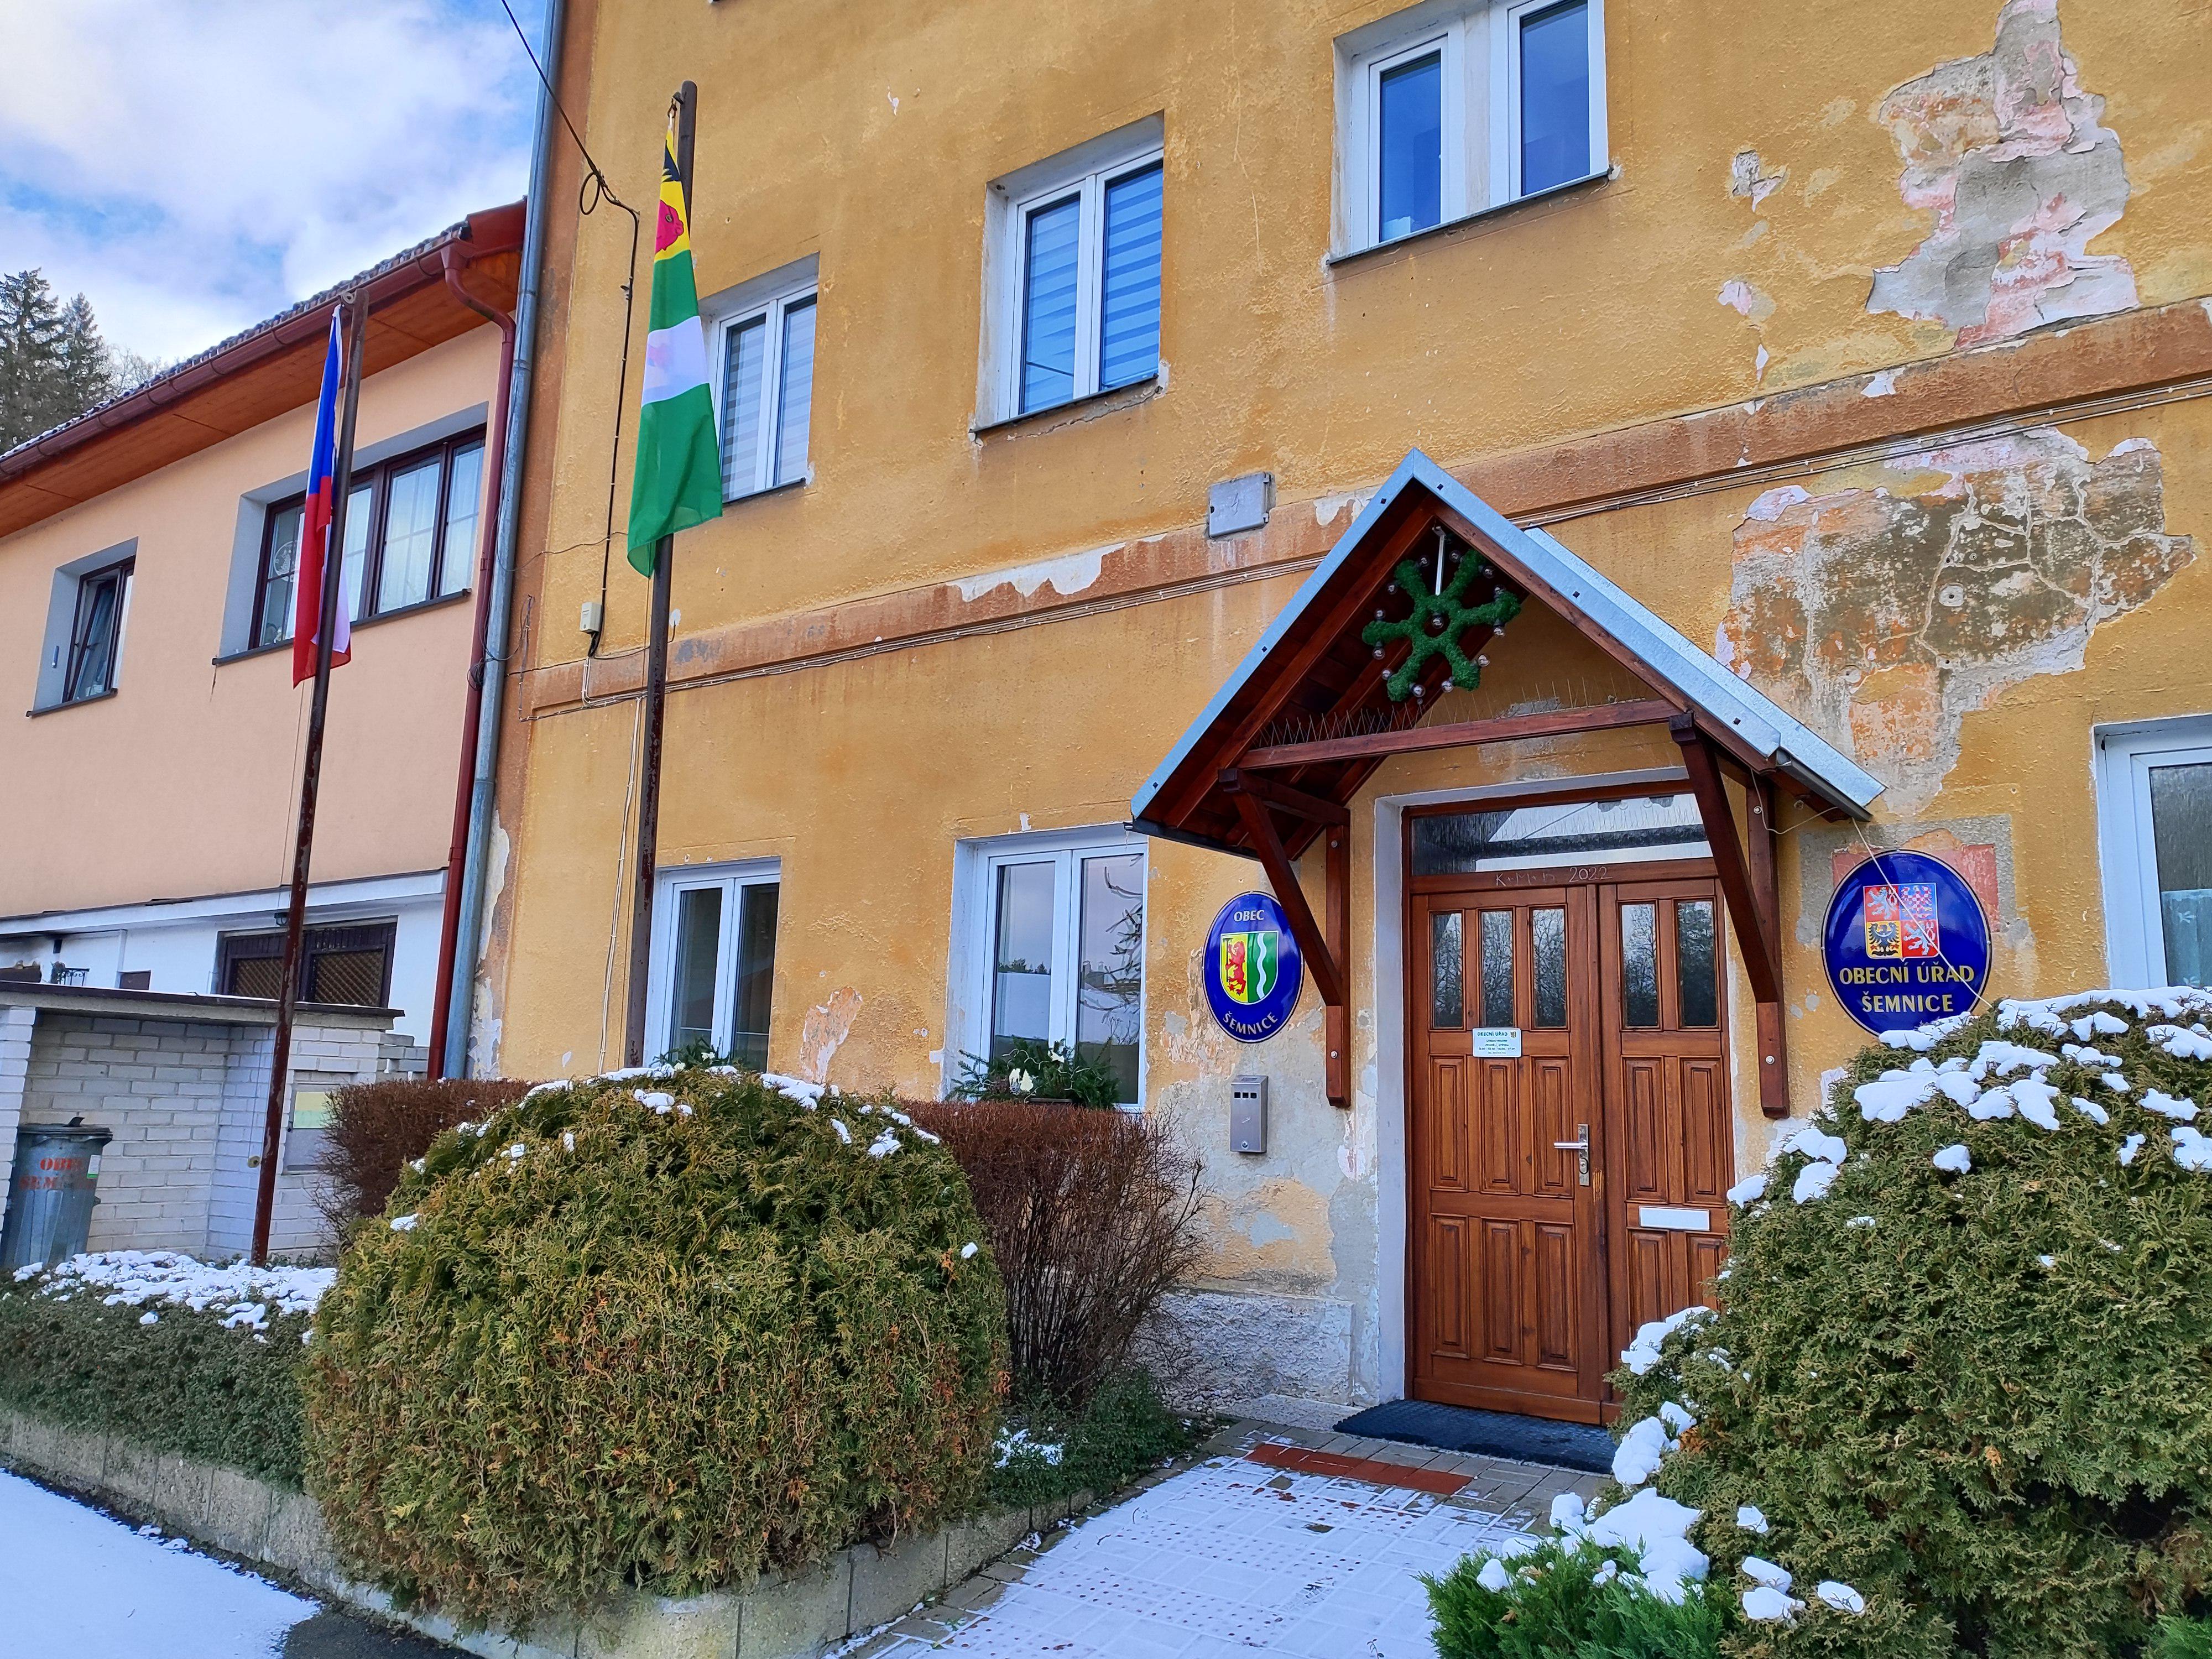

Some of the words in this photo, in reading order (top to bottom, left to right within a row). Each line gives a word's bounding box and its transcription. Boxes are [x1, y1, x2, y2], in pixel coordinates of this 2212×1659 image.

[1569, 867, 1613, 883] 2022
[1234, 910, 1265, 922] OBEC
[1839, 962, 1909, 984] OBECNÍ
[1917, 961, 1975, 983] ÚŘAD
[1862, 991, 1954, 1013] ŠEMNICE
[1223, 1011, 1279, 1035] ŠEMNICE
